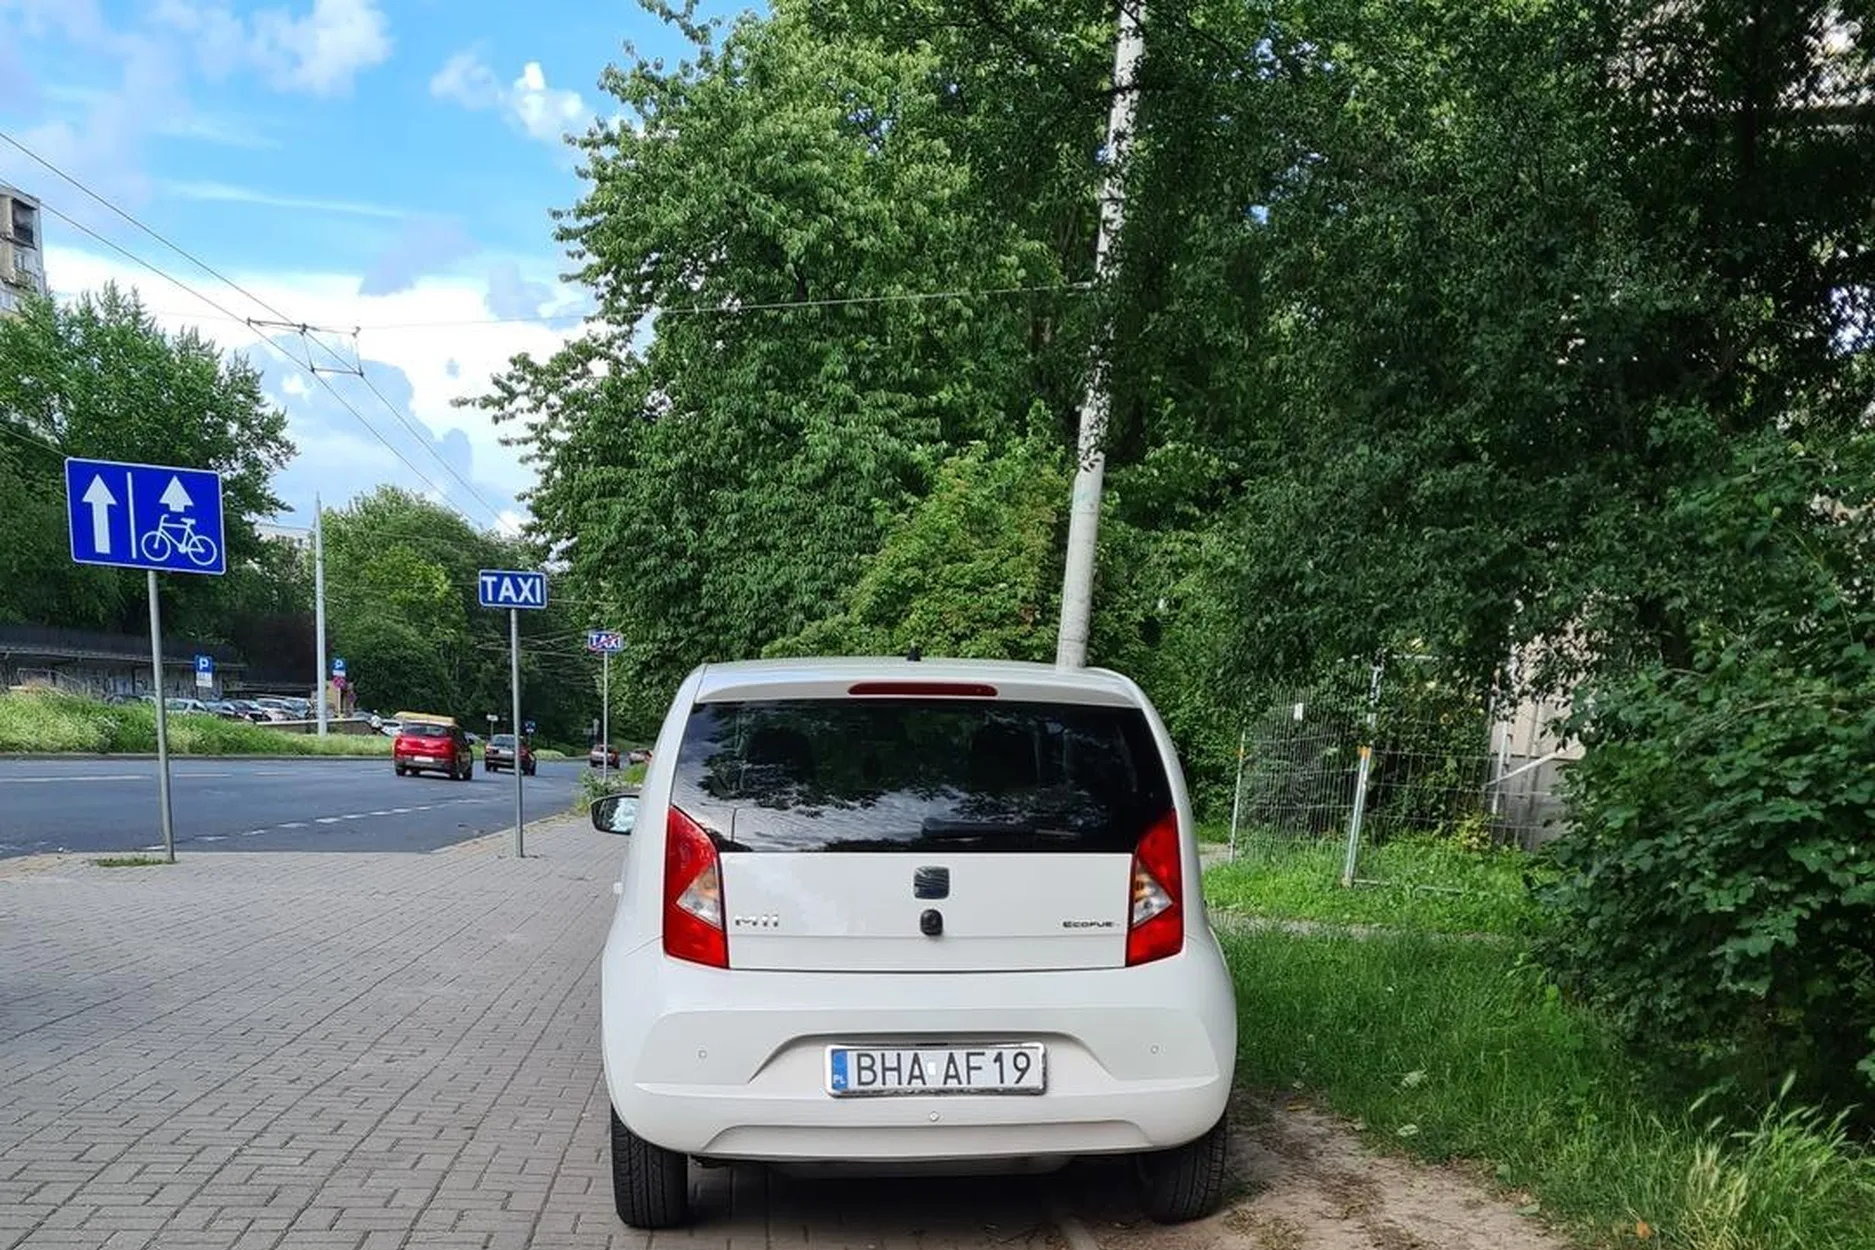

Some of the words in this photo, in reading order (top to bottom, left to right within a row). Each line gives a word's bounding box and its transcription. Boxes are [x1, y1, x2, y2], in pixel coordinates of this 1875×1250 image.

[481, 575, 542, 604] TAXI
[592, 634, 621, 648] TAXI
[199, 658, 209, 670] P
[856, 1052, 927, 1086] BHA
[943, 1051, 1031, 1085] AF19
[832, 1074, 845, 1084] PL
